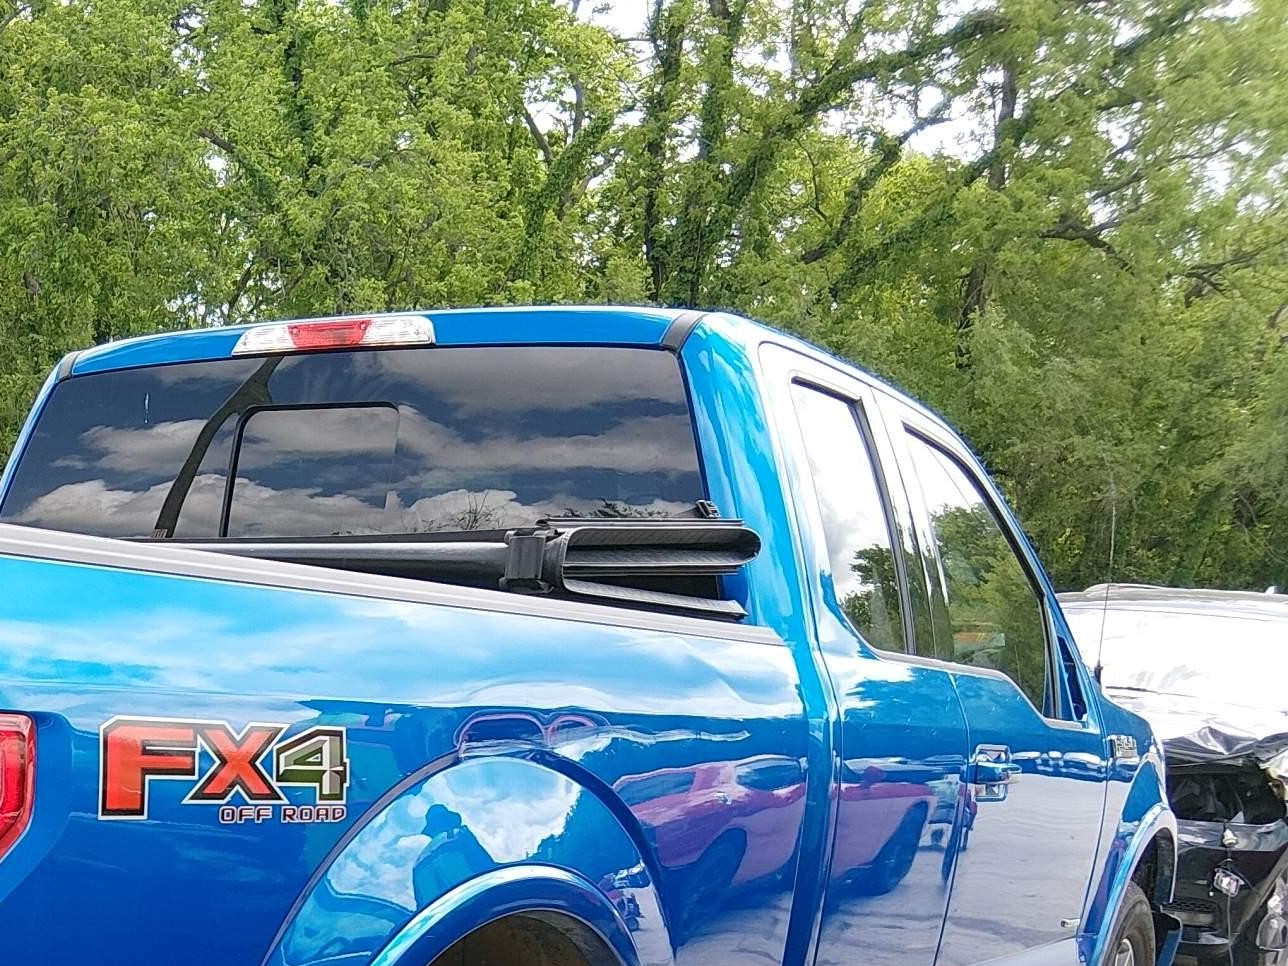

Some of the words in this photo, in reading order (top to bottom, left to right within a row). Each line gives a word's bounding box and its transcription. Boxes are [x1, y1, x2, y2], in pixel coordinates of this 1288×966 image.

[98, 715, 350, 820] FX4
[219, 804, 273, 824] OFF
[281, 805, 348, 824] ROAD
